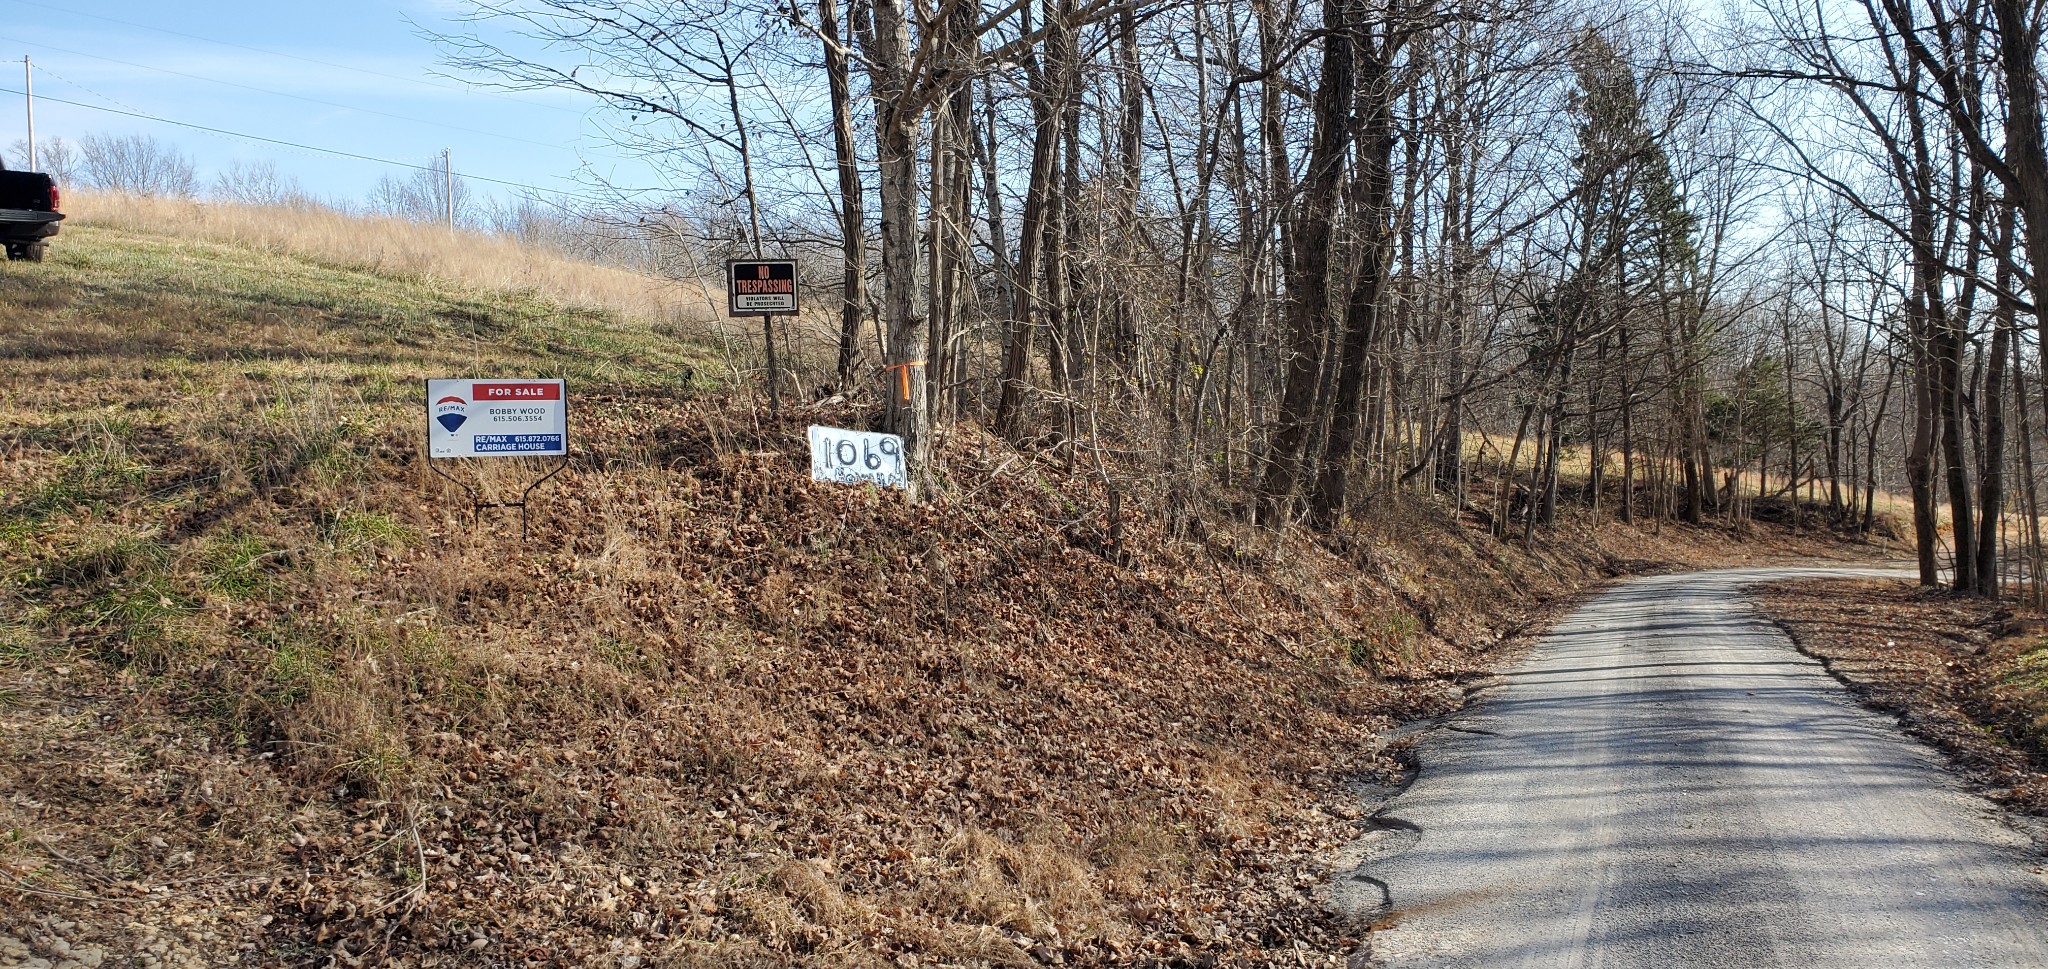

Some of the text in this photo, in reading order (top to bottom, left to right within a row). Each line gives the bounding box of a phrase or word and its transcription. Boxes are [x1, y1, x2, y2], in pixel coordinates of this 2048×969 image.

[758, 266, 769, 279] NO
[736, 279, 792, 293] TRESPASSING
[488, 388, 511, 396] FOR
[476, 443, 516, 451] CARRIAGE
[824, 437, 902, 474] 1069
